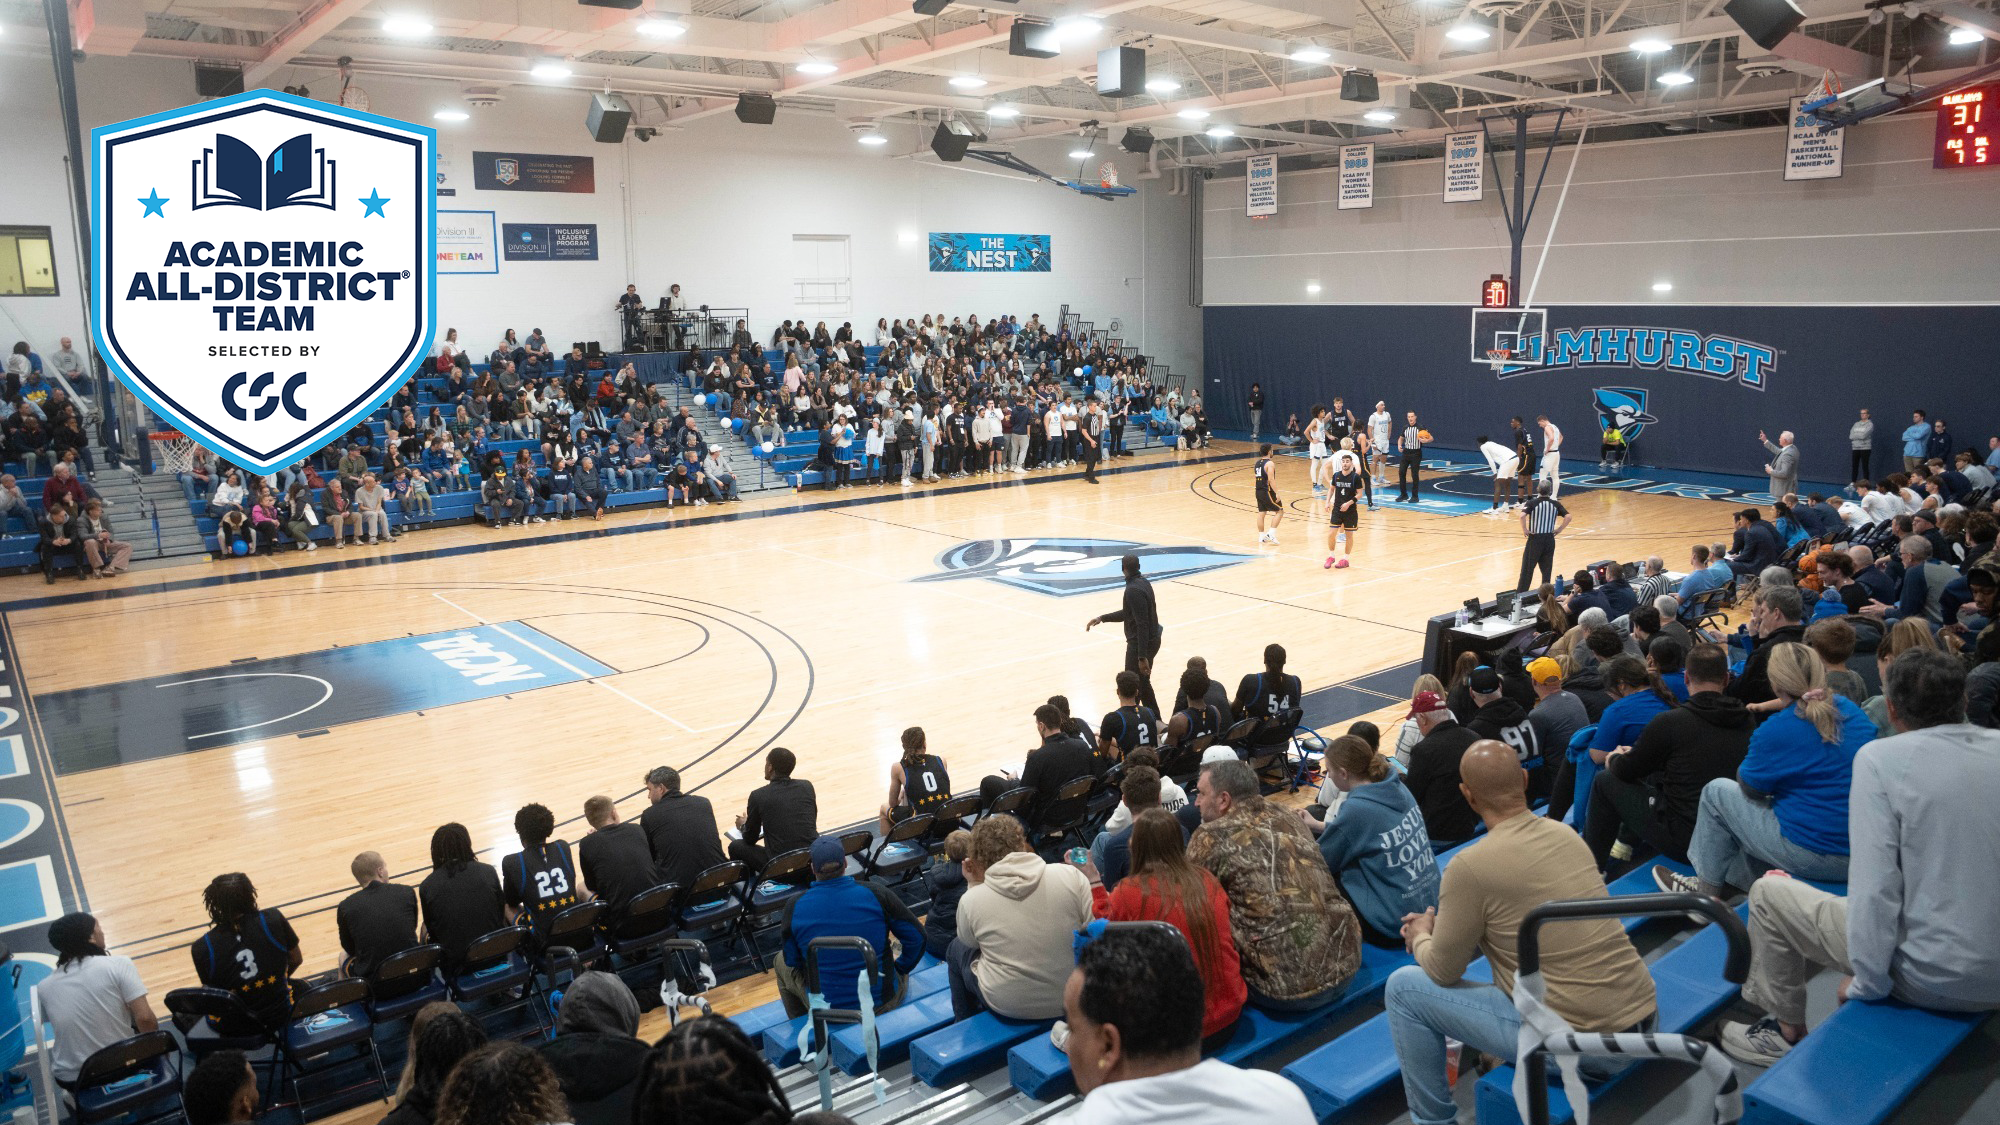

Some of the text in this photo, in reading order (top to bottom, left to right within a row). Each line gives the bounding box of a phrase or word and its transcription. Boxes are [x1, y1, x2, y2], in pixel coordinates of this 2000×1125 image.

[1942, 92, 1982, 105] BLUEJAYS
[1954, 104, 1980, 125] 31
[1791, 145, 1838, 153] BASKETBALL
[1947, 139, 1963, 149] FLS
[1451, 148, 1477, 159] 1987
[1955, 148, 1986, 163] 7 5
[501, 165, 514, 174] 50
[980, 238, 1004, 248] THE
[966, 251, 1017, 268] NEST
[1487, 289, 1504, 305] 30
[1497, 326, 1777, 392] LMHURST
[1268, 694, 1290, 714] 54
[1137, 723, 1149, 744] 2
[1501, 719, 1539, 761] 97
[922, 772, 937, 792] 0
[1403, 847, 1434, 881] YOU
[535, 867, 568, 898] 23
[236, 949, 258, 980] 3
